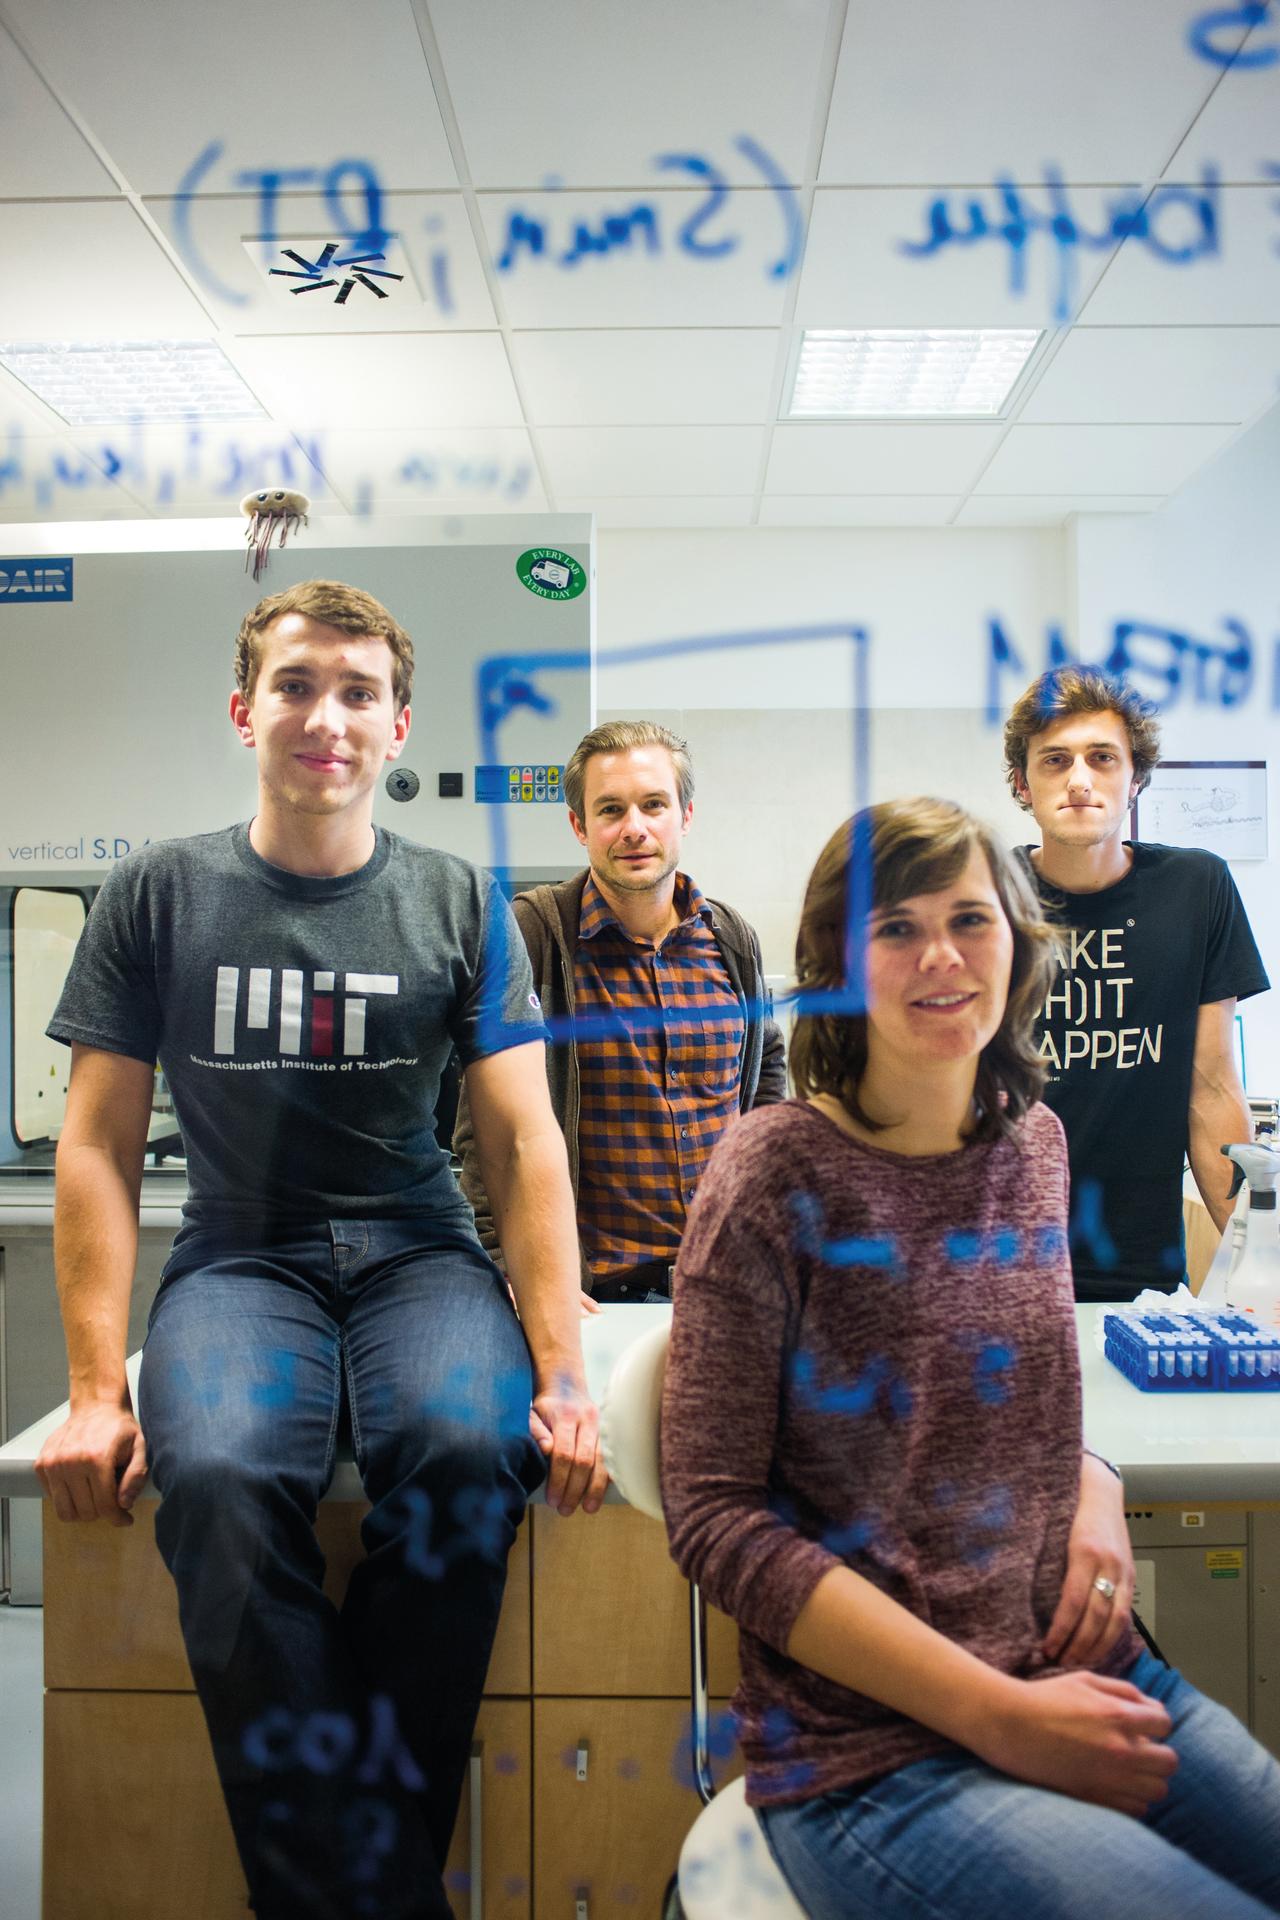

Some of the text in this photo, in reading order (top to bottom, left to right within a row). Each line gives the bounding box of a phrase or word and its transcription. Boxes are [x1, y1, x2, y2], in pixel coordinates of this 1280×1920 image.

[532, 551, 581, 575] EVERY LAB
[523, 574, 571, 599] EVERY DAY
[8, 837, 84, 860] vertical
[1038, 1024, 1163, 1070] APPEN
[281, 1059, 336, 1072] Institute
[340, 1061, 352, 1071] of
